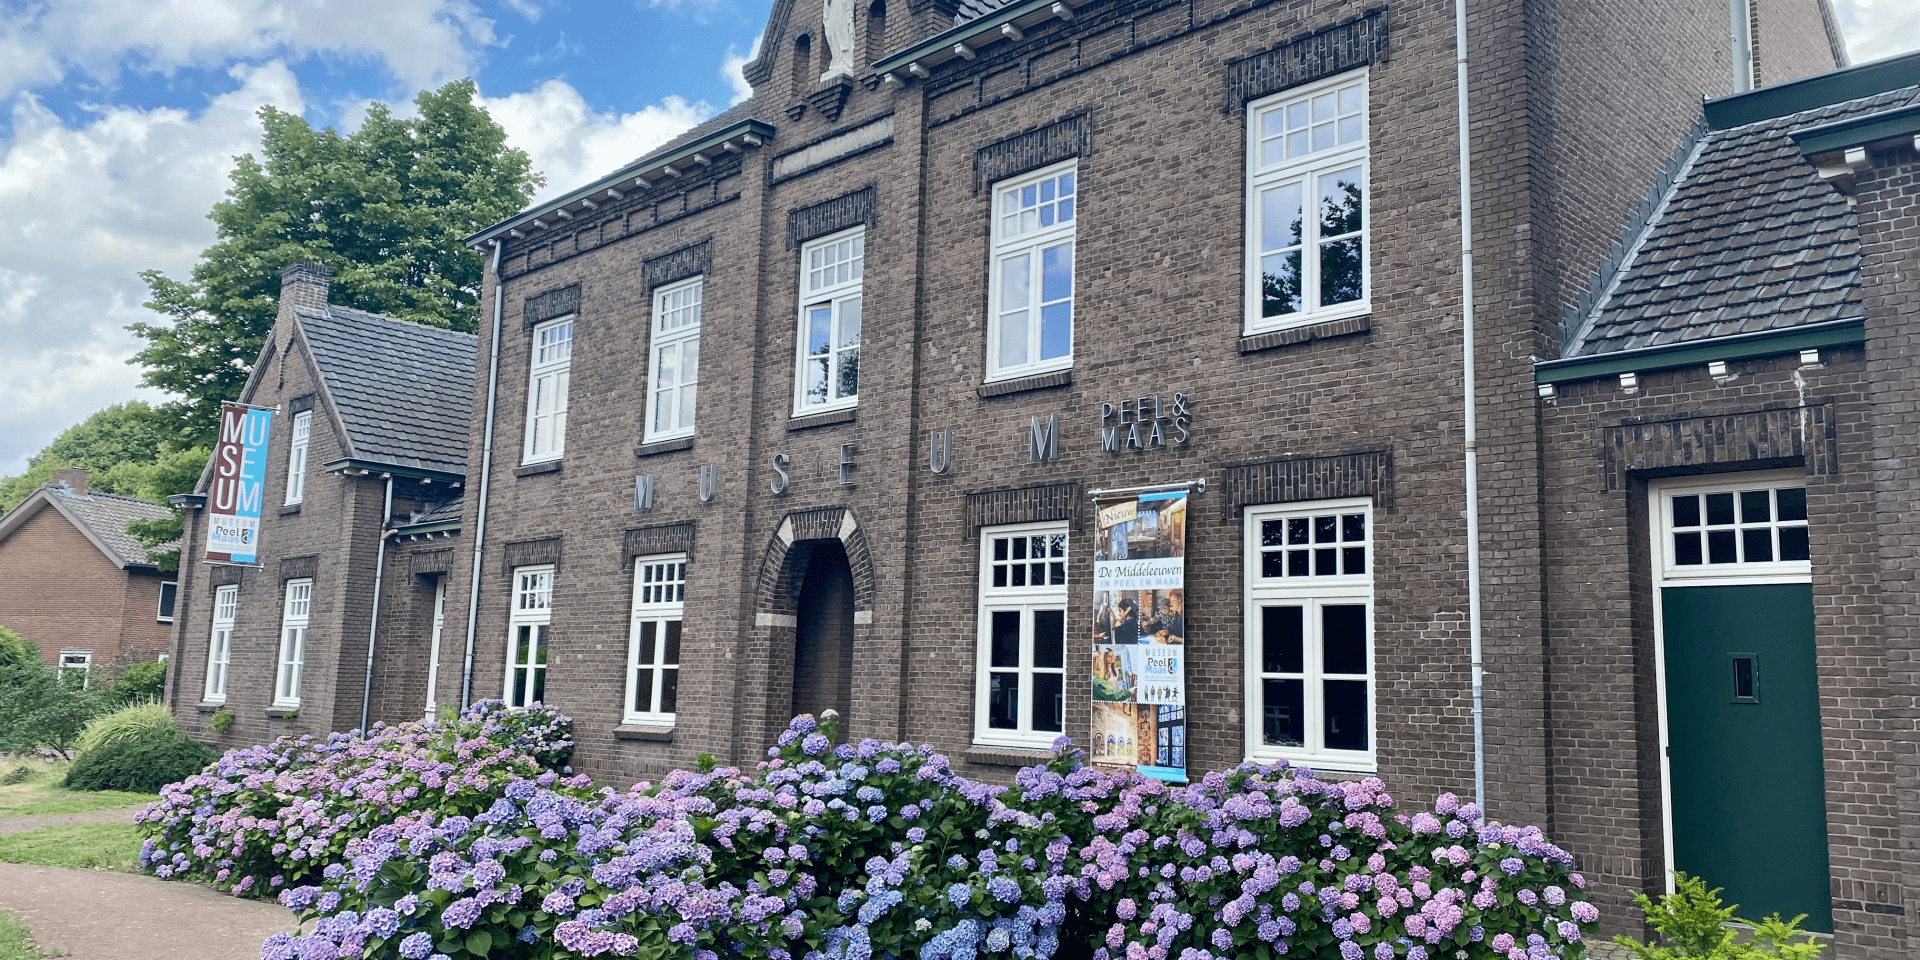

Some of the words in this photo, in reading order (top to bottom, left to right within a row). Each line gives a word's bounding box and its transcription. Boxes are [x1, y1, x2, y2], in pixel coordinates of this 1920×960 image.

[1101, 416, 1191, 453] MAAS
[213, 516, 256, 528] MUSEUM
[1104, 508, 1133, 524] Nieuw
[216, 525, 240, 537] Peel
[211, 532, 240, 544] Maas
[1098, 566, 1112, 577] De
[1115, 562, 1182, 577] Middeleeuwen
[1100, 579, 1110, 588] IN
[1114, 579, 1135, 587] PEEL
[1140, 579, 1151, 587] EN
[1155, 578, 1180, 586] MAAS
[1145, 648, 1177, 656] MUSEUM
[1148, 657, 1166, 667] Peel
[1145, 664, 1167, 673] Maas
